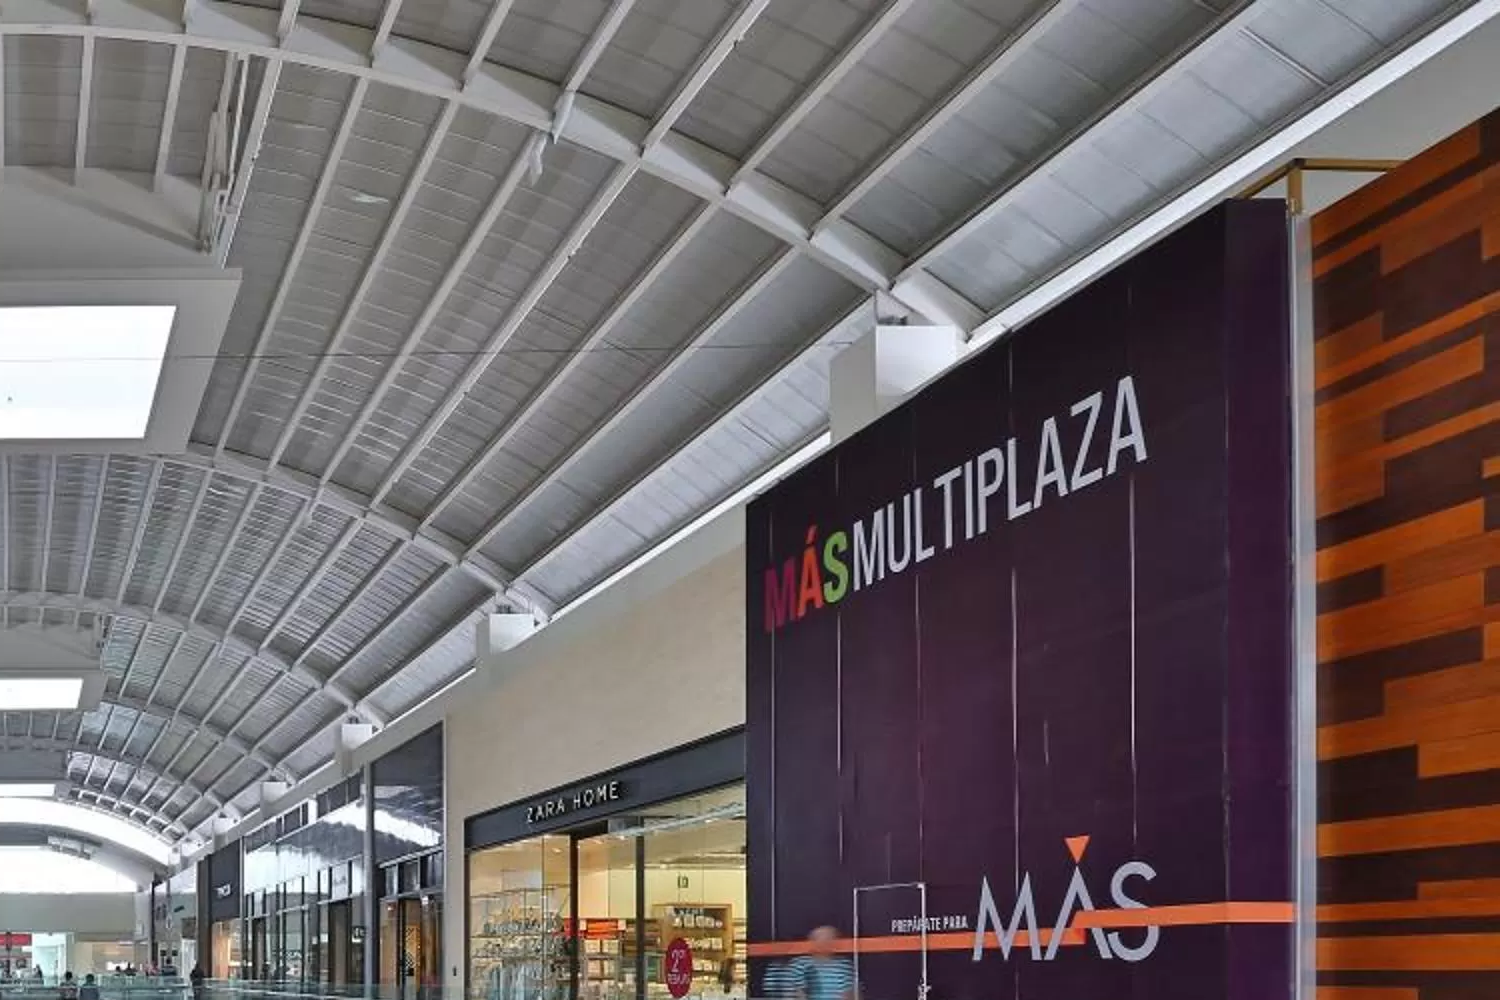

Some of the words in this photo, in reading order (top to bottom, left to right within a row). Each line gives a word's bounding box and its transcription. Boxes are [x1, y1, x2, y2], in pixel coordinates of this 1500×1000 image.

[526, 798, 565, 823] ZARA
[573, 781, 619, 809] HOME
[943, 915, 969, 930] PARA
